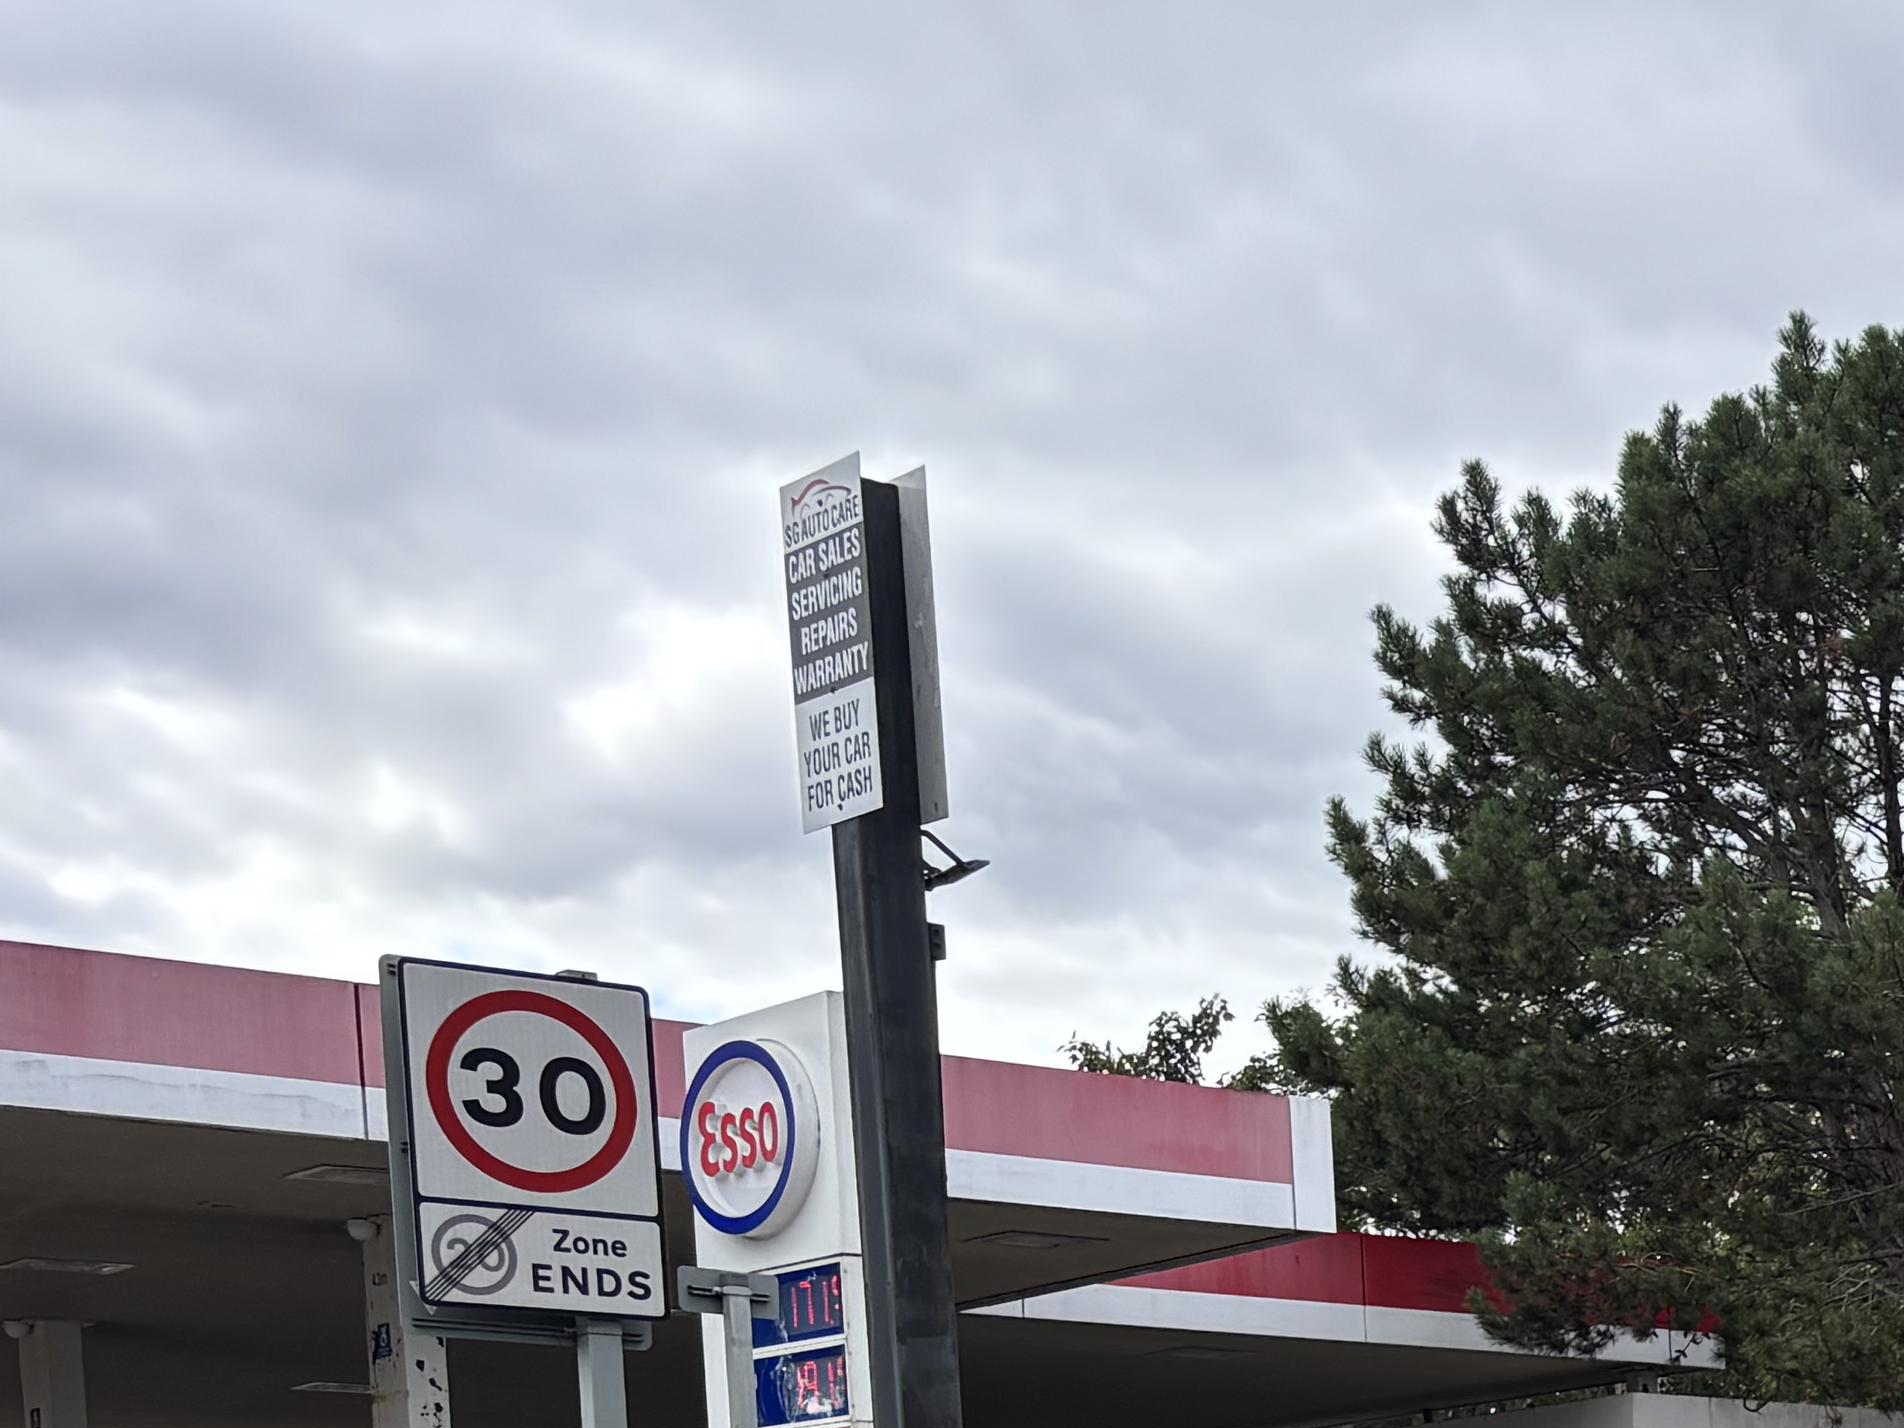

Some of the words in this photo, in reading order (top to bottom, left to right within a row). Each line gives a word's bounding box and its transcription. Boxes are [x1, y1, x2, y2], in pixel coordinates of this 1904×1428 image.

[785, 522, 800, 548] SG
[801, 508, 829, 543] AUTO
[830, 495, 859, 529] CARE
[788, 548, 816, 584] CAR
[818, 527, 861, 572] SALES
[791, 566, 862, 621] SERVICING
[801, 607, 858, 655] REPAIRS
[794, 641, 869, 695] WARRANTY
[809, 710, 830, 742] WE
[834, 698, 860, 734] BUY
[804, 742, 841, 778] YOUR
[844, 731, 872, 765] CAR
[807, 779, 834, 812] FOR
[837, 765, 873, 803] CASH
[459, 1047, 607, 1135] 30
[552, 1228, 627, 1258] Zone
[531, 1263, 652, 1300] ENDS
